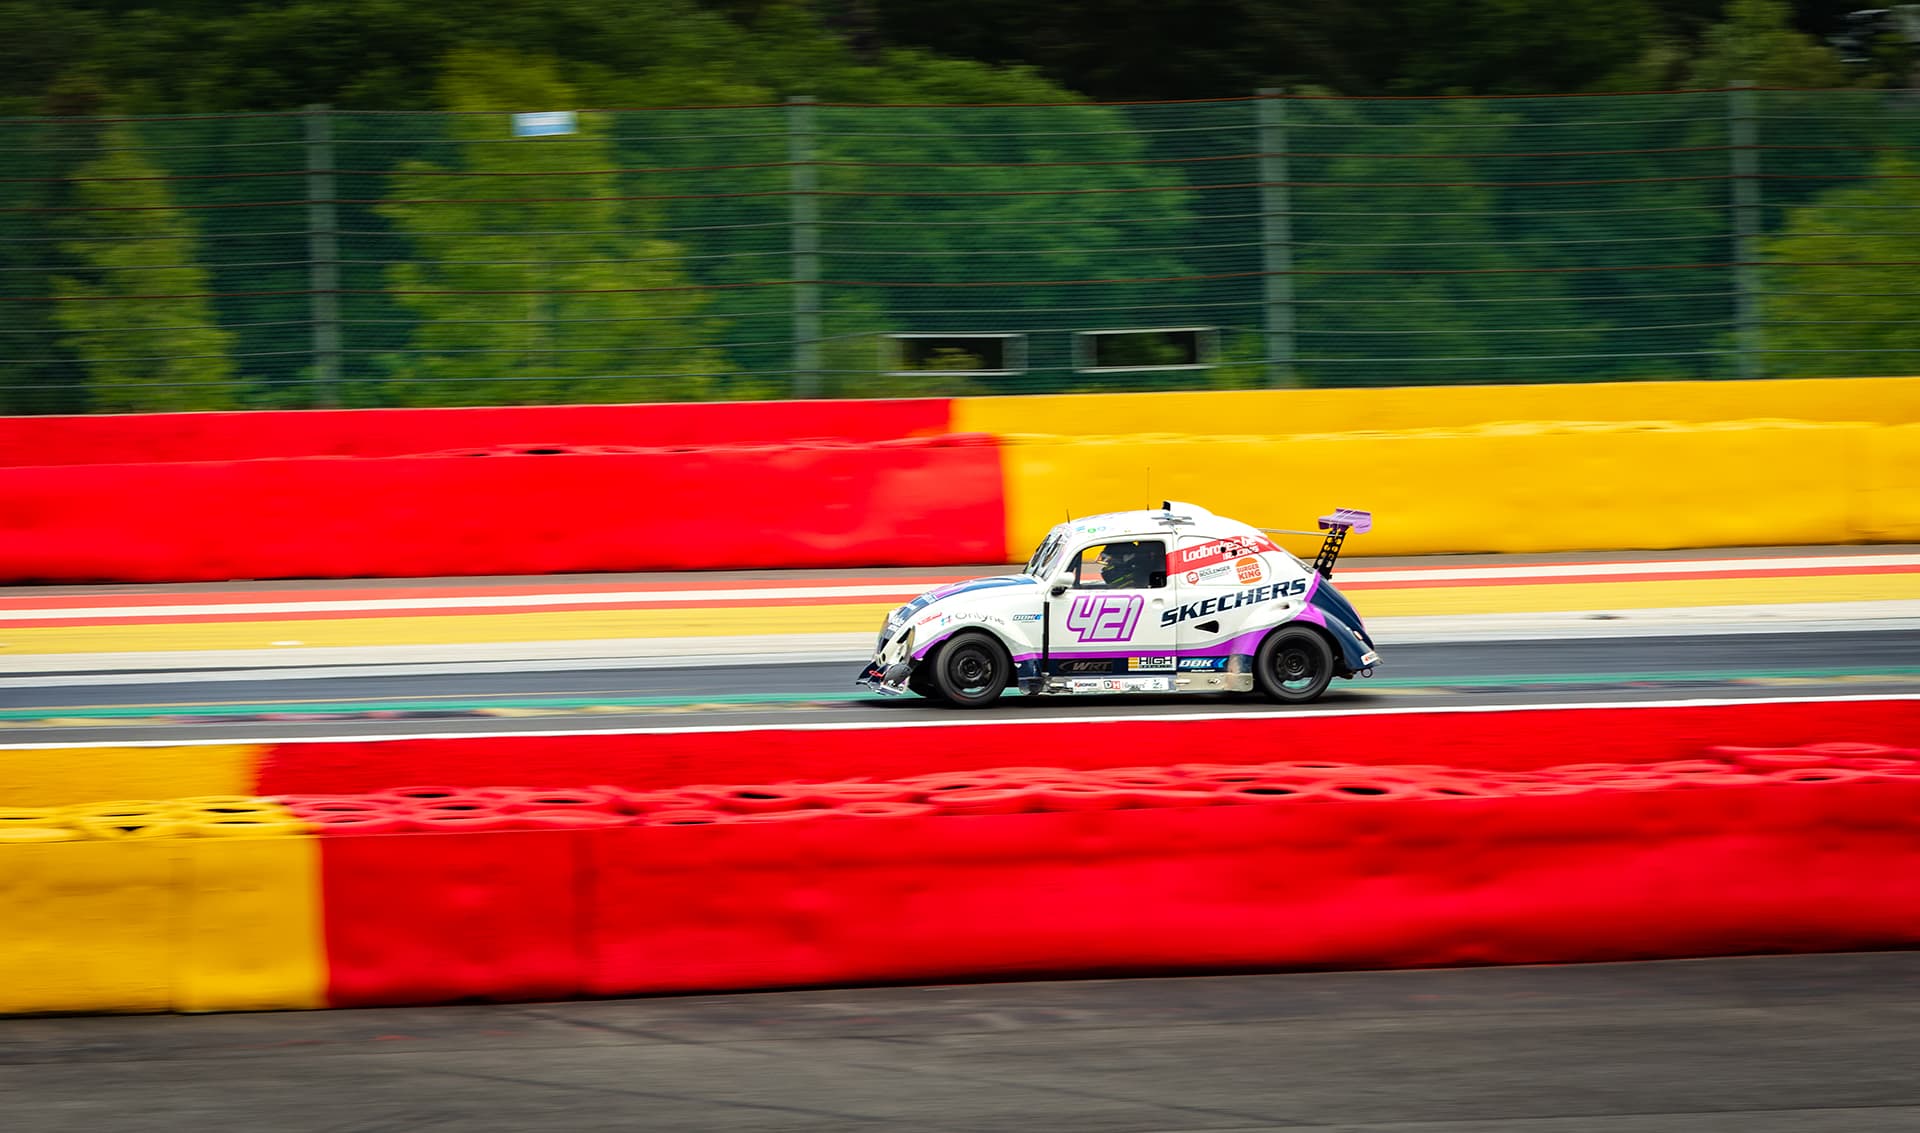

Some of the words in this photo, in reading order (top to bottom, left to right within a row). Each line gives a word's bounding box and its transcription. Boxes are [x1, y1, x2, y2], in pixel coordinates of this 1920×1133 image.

[1238, 569, 1262, 580] KING
[1160, 578, 1306, 627] SKECHERS
[1066, 594, 1144, 642] 421
[1139, 657, 1173, 665] HIGH
